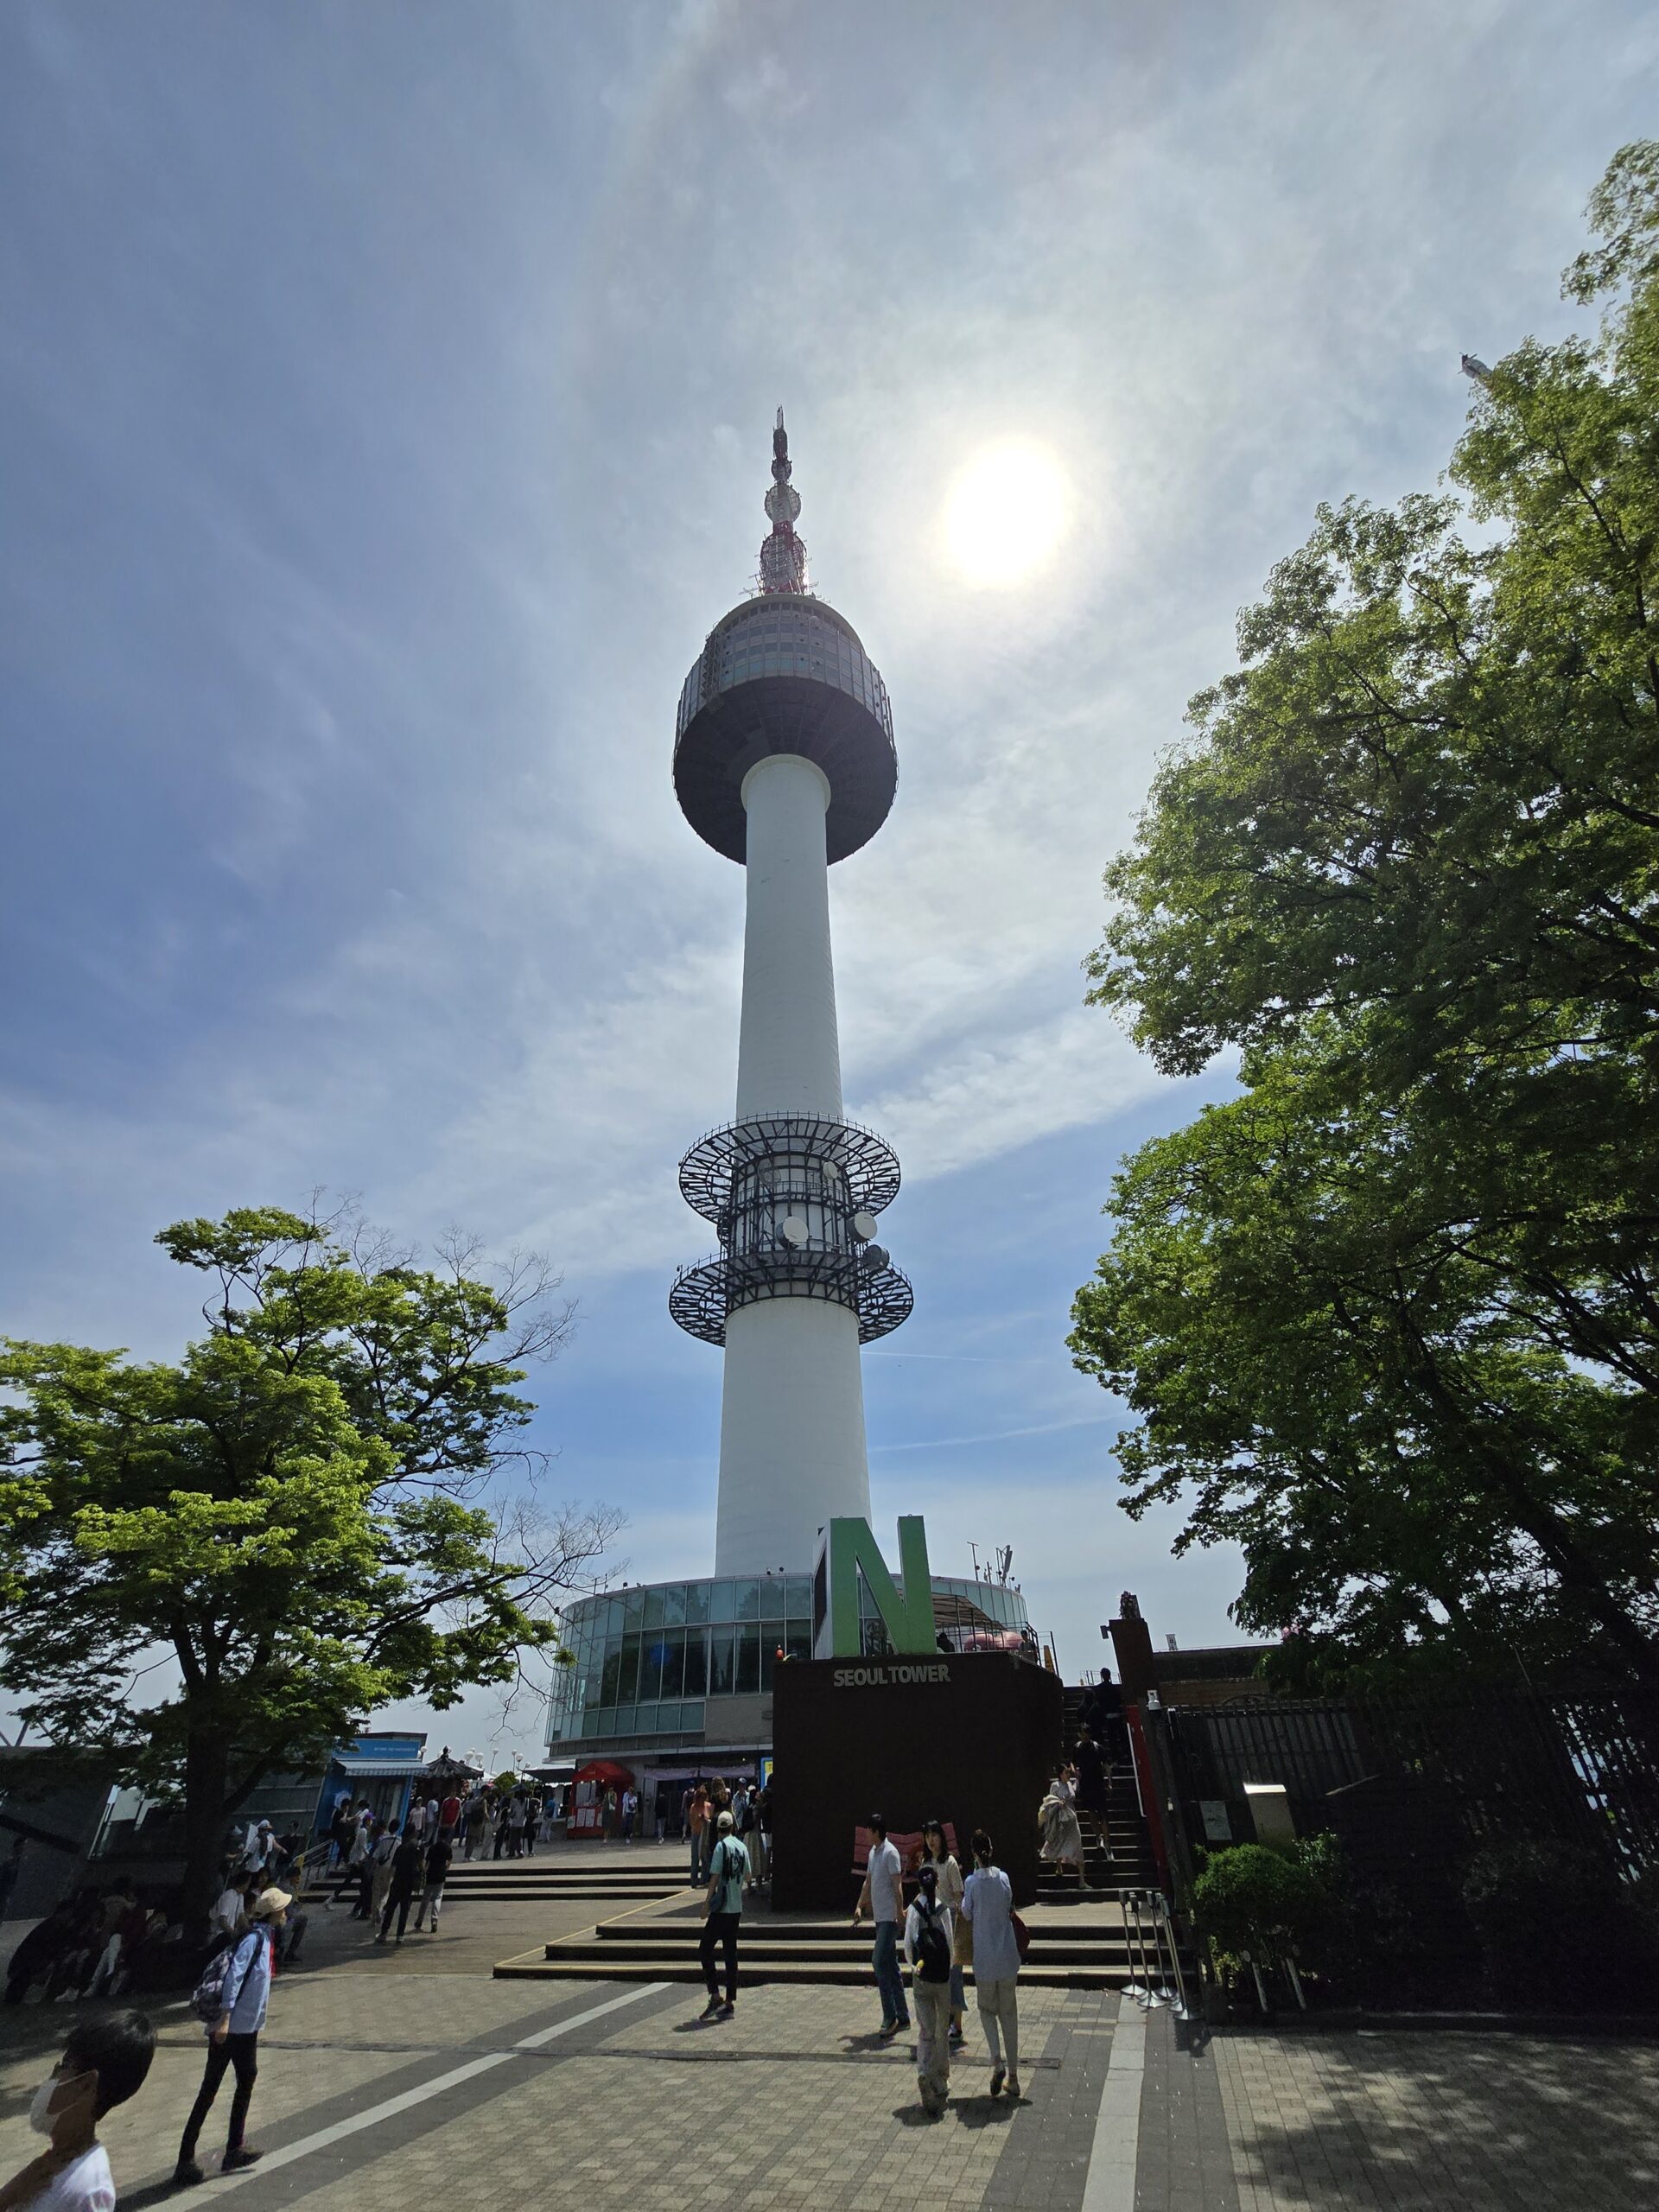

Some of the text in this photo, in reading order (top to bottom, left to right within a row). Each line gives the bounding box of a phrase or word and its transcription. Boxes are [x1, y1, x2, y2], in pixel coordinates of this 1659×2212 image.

[830, 1516, 938, 1657] N
[834, 1664, 950, 1687] SEOUL TOWER
